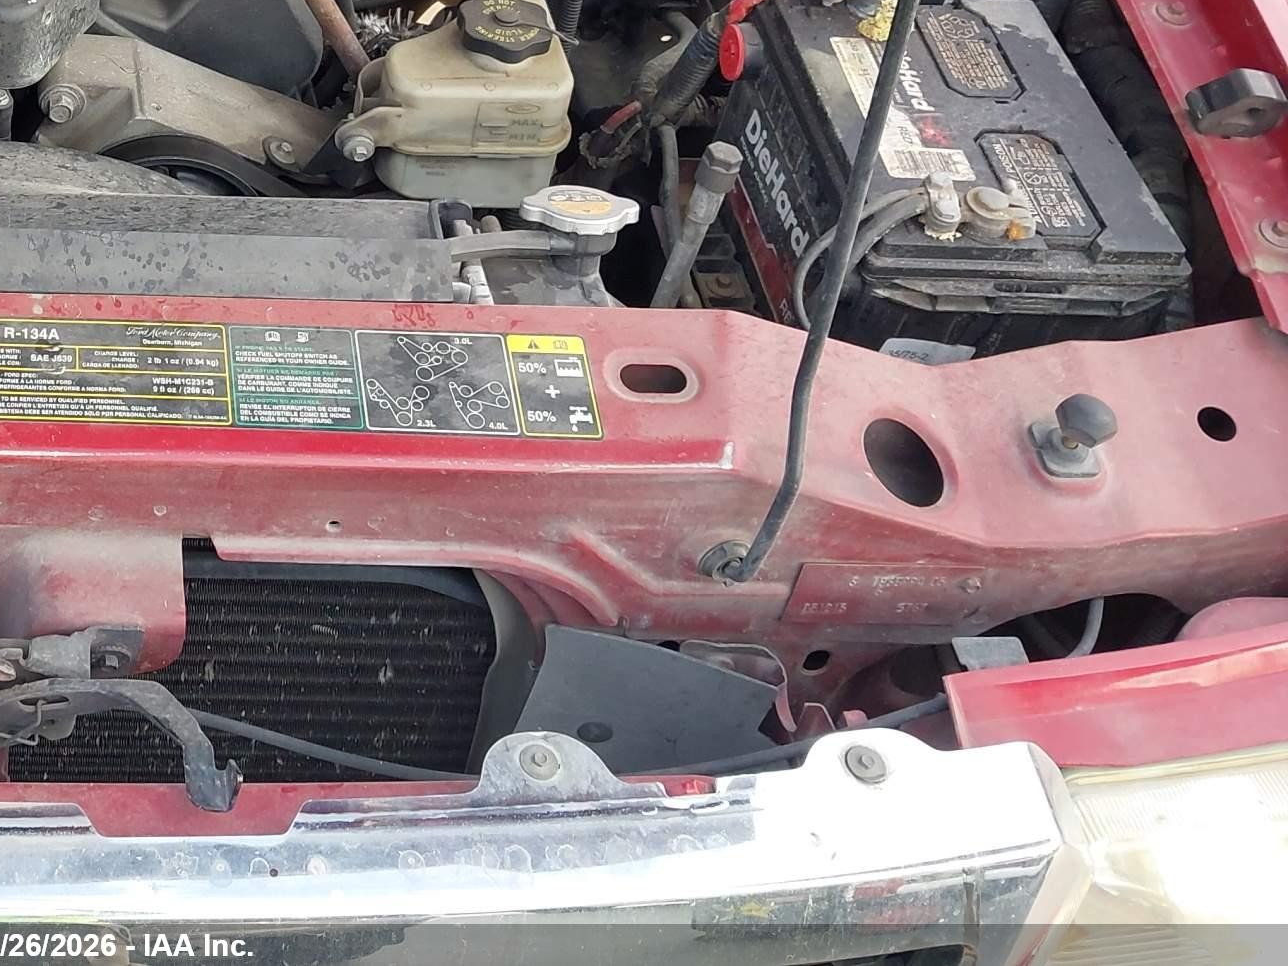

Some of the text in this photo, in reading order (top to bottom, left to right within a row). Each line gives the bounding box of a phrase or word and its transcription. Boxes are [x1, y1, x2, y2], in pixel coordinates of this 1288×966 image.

[745, 108, 810, 258] DieHard
[4, 326, 60, 340] R-134A
[126, 326, 220, 340] Ford Motor Company
[174, 338, 203, 347] Michigan
[454, 337, 472, 346] 3.0L
[30, 353, 73, 363] SAE J639
[518, 362, 547, 376] 50%
[526, 410, 557, 423] 50%
[416, 419, 436, 428] 2.3L
[489, 422, 508, 430] 4.0L
